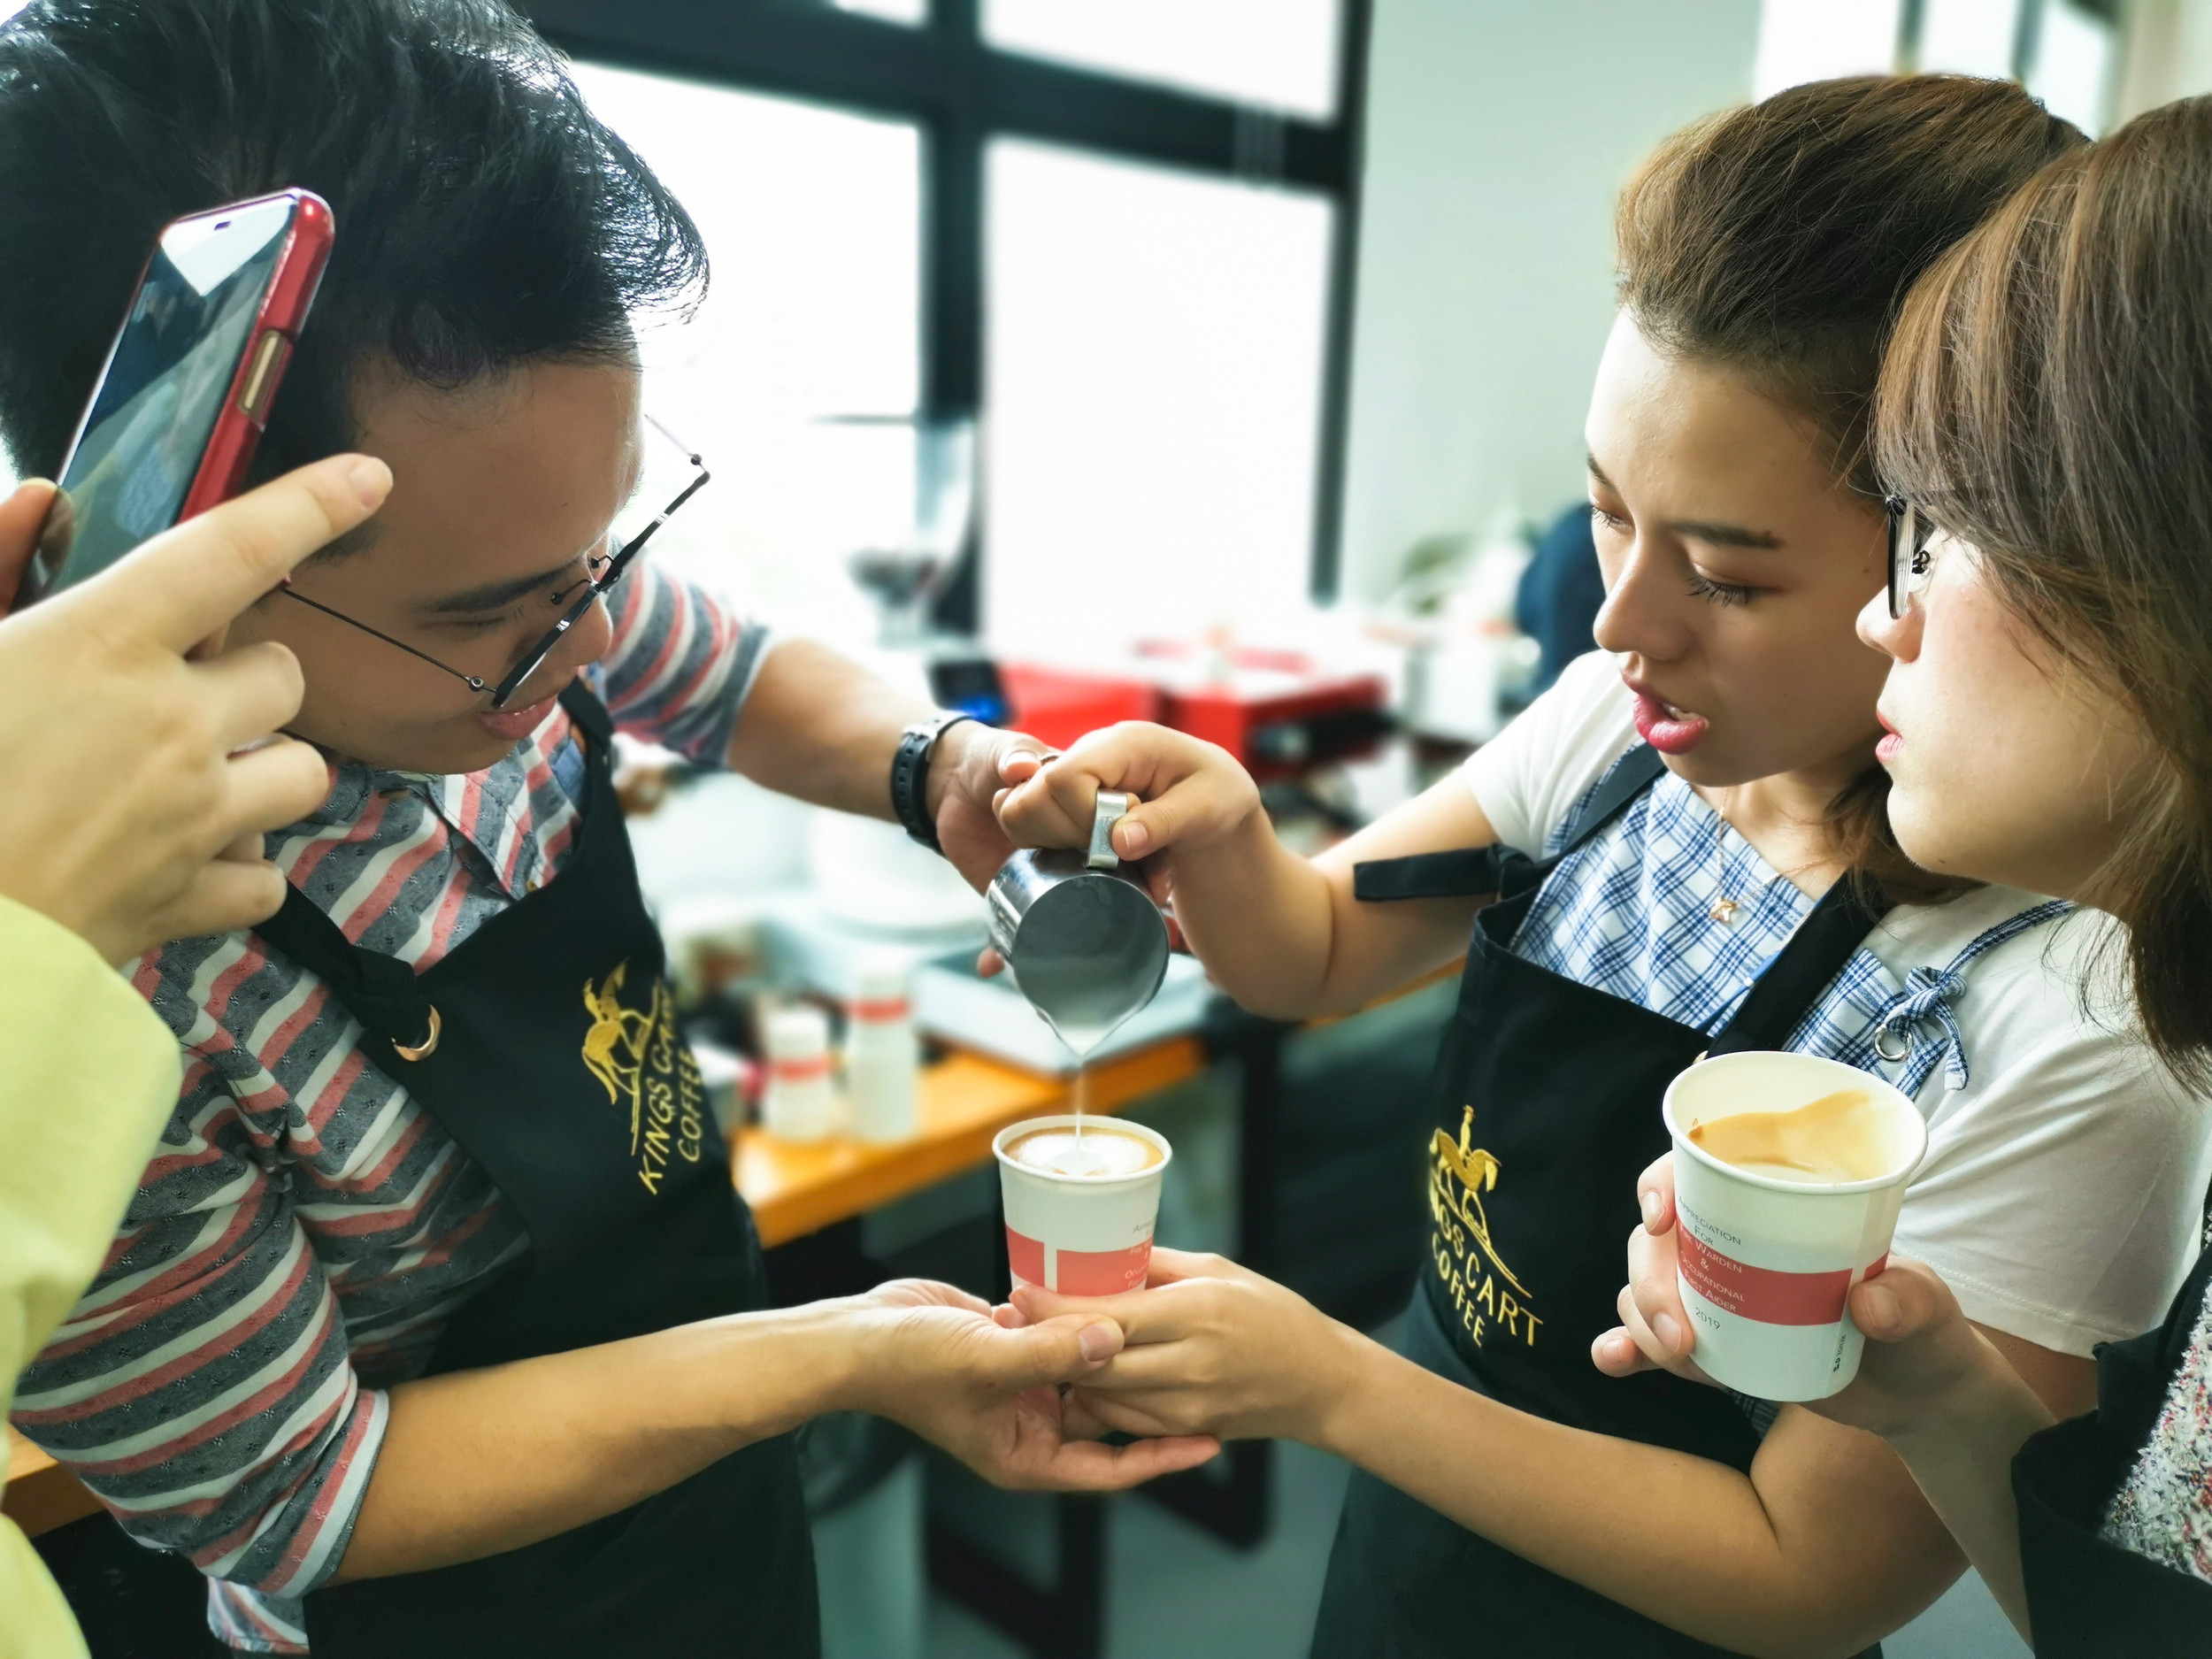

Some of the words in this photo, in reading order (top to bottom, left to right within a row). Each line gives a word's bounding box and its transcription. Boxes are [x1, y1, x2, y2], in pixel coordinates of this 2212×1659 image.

[639, 1077, 673, 1194] KINGS
[1694, 1225, 1714, 1246] FOR
[1694, 1239, 1742, 1273] WARDEN
[1700, 1257, 1709, 1271] &
[1432, 1231, 1485, 1348] COFFEE
[1465, 1252, 1543, 1347] CART
[1705, 1290, 1737, 1313] AIDER
[1694, 1307, 1721, 1330] 2019
